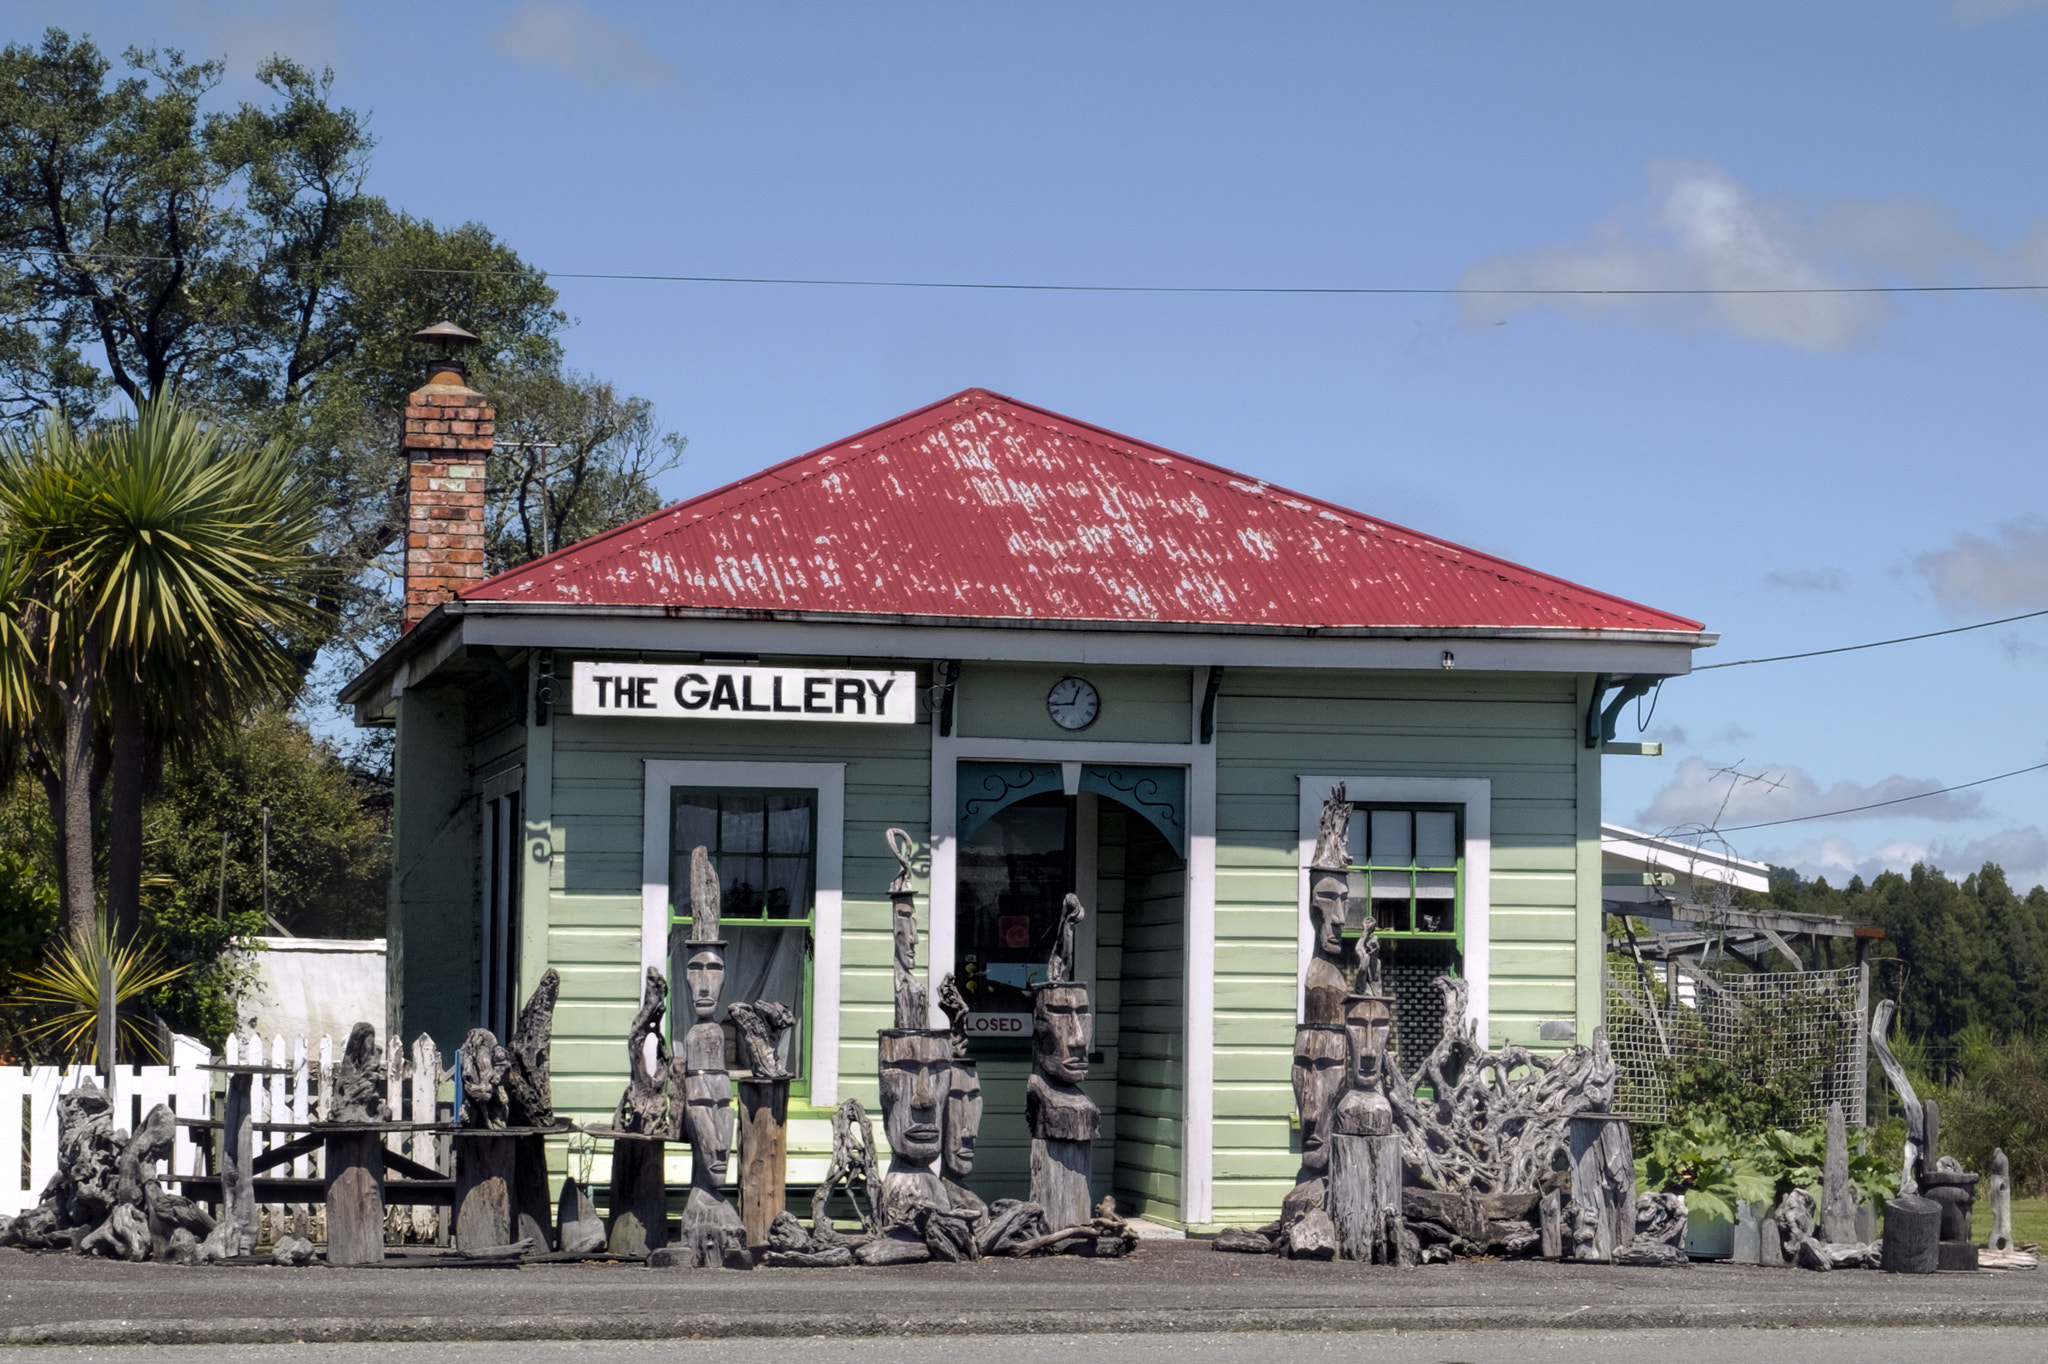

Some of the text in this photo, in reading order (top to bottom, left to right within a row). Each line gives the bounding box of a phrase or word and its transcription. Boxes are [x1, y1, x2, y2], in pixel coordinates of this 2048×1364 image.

[592, 672, 896, 716] THE GALLERY
[964, 1017, 1023, 1032] LOSED
